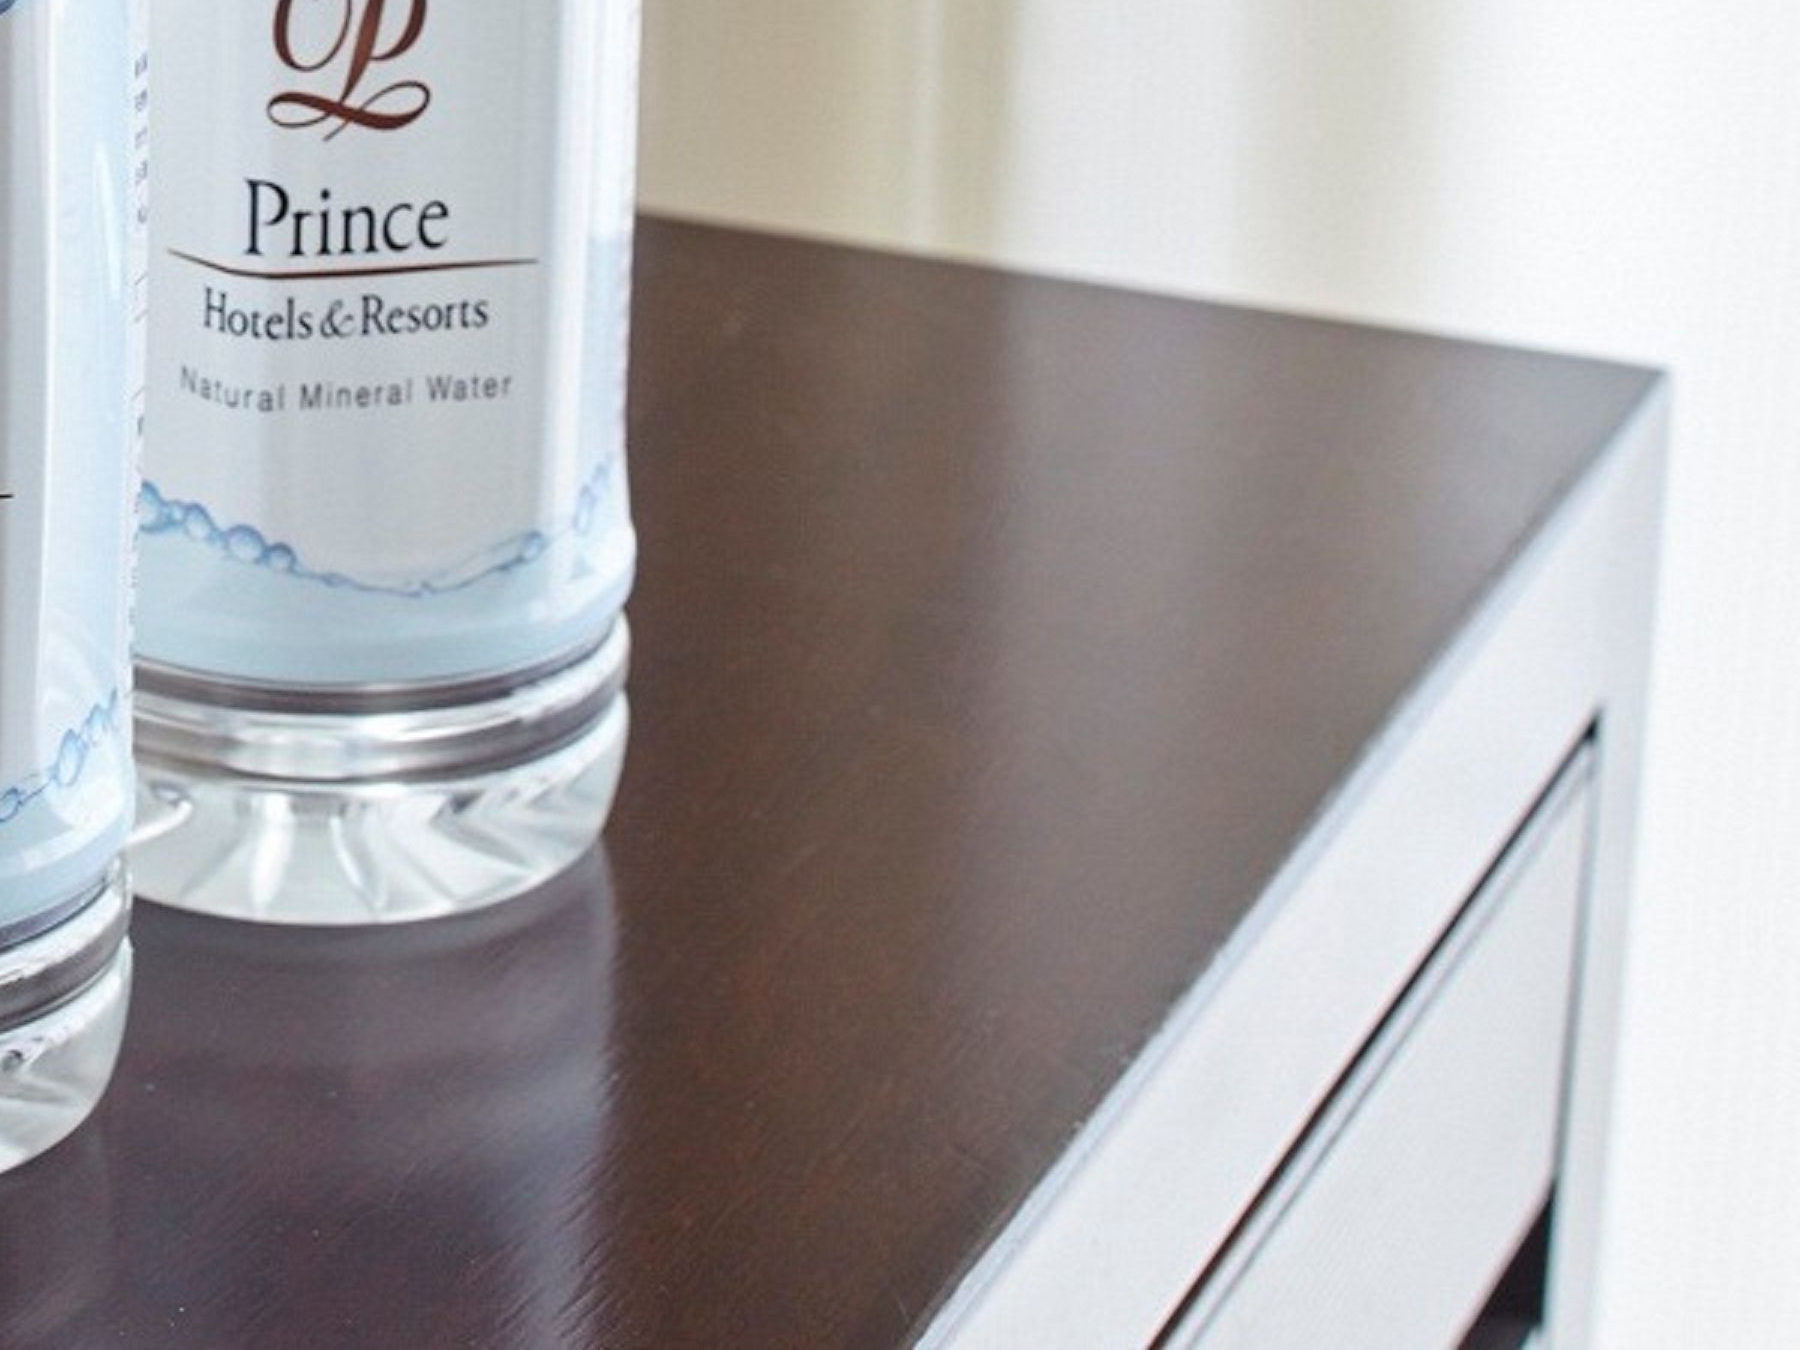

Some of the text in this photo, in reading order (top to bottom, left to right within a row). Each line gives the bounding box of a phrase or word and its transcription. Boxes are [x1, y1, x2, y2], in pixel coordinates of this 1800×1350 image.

[243, 178, 450, 257] Prince
[202, 286, 314, 341] Hotels
[360, 293, 490, 338] Resorts
[179, 364, 513, 413] Natural Mineral Water
